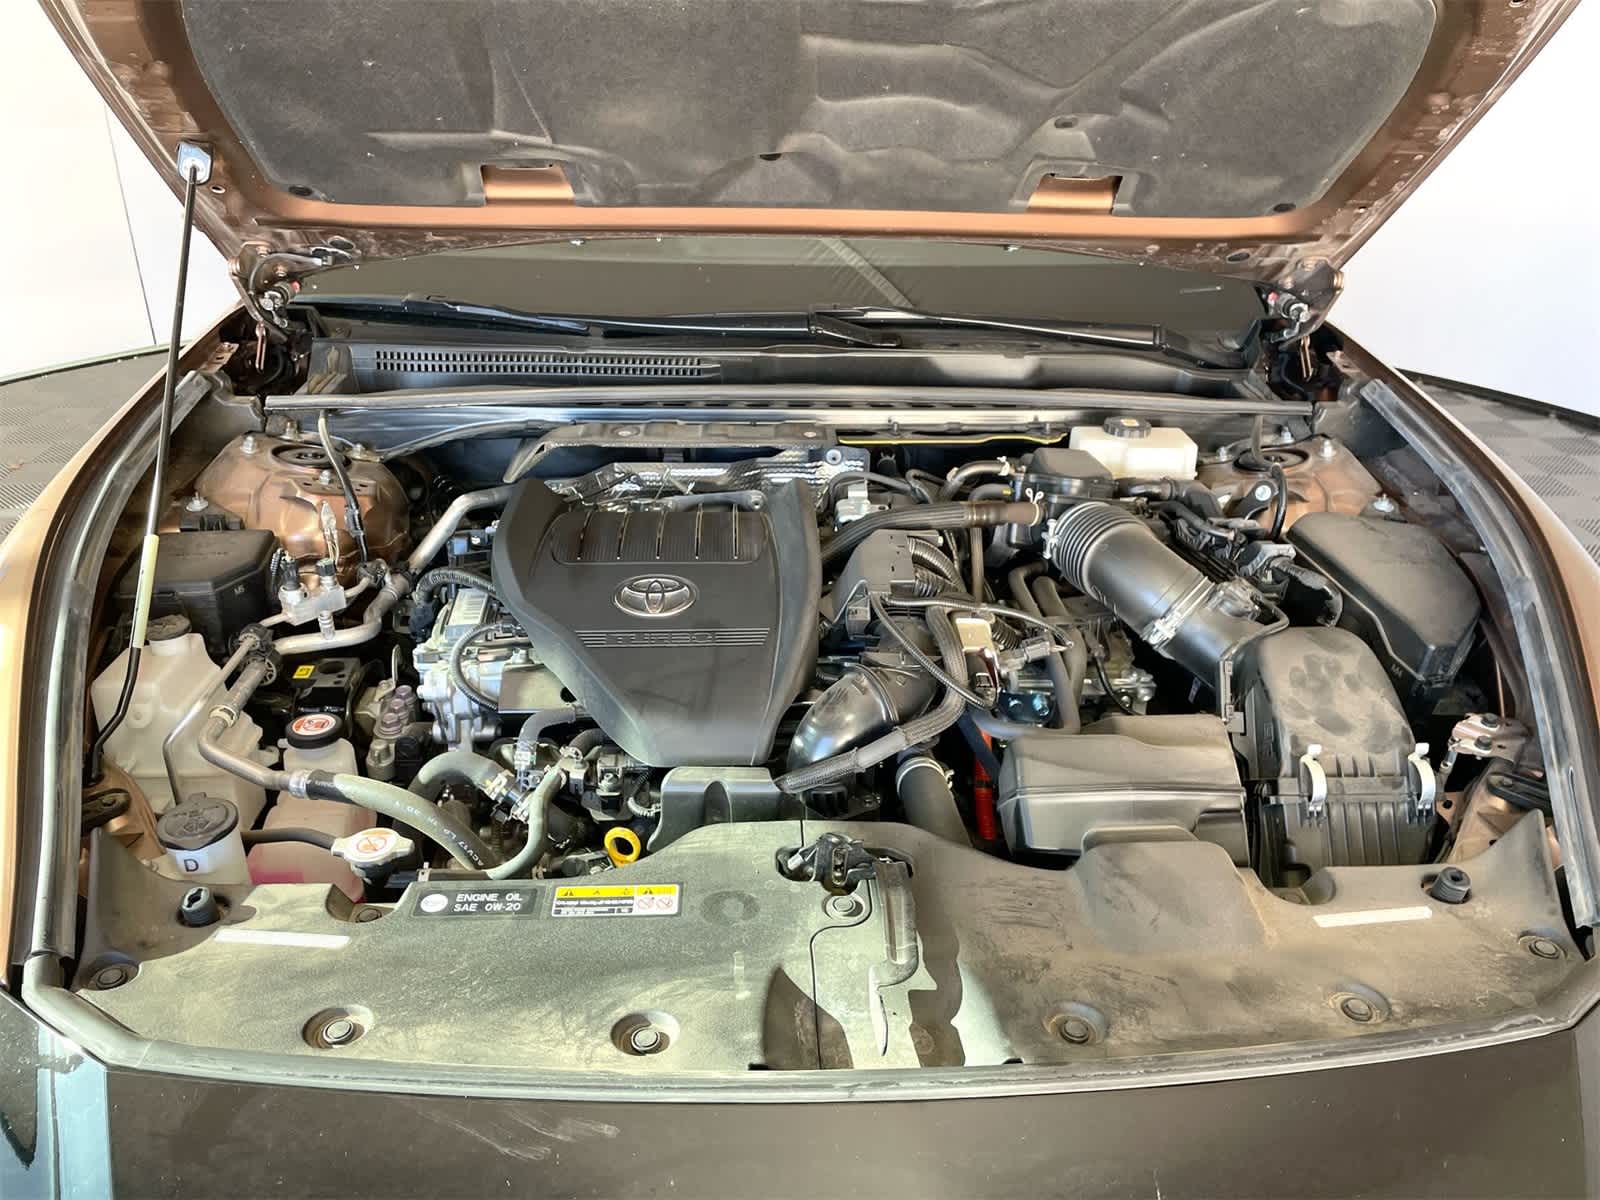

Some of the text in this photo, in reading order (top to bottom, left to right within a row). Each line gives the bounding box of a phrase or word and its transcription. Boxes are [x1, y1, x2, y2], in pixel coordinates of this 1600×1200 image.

[183, 858, 200, 873] D
[455, 891, 524, 902] ENGINE OIL
[453, 902, 479, 912] SAE
[484, 901, 522, 912] 0W-20
